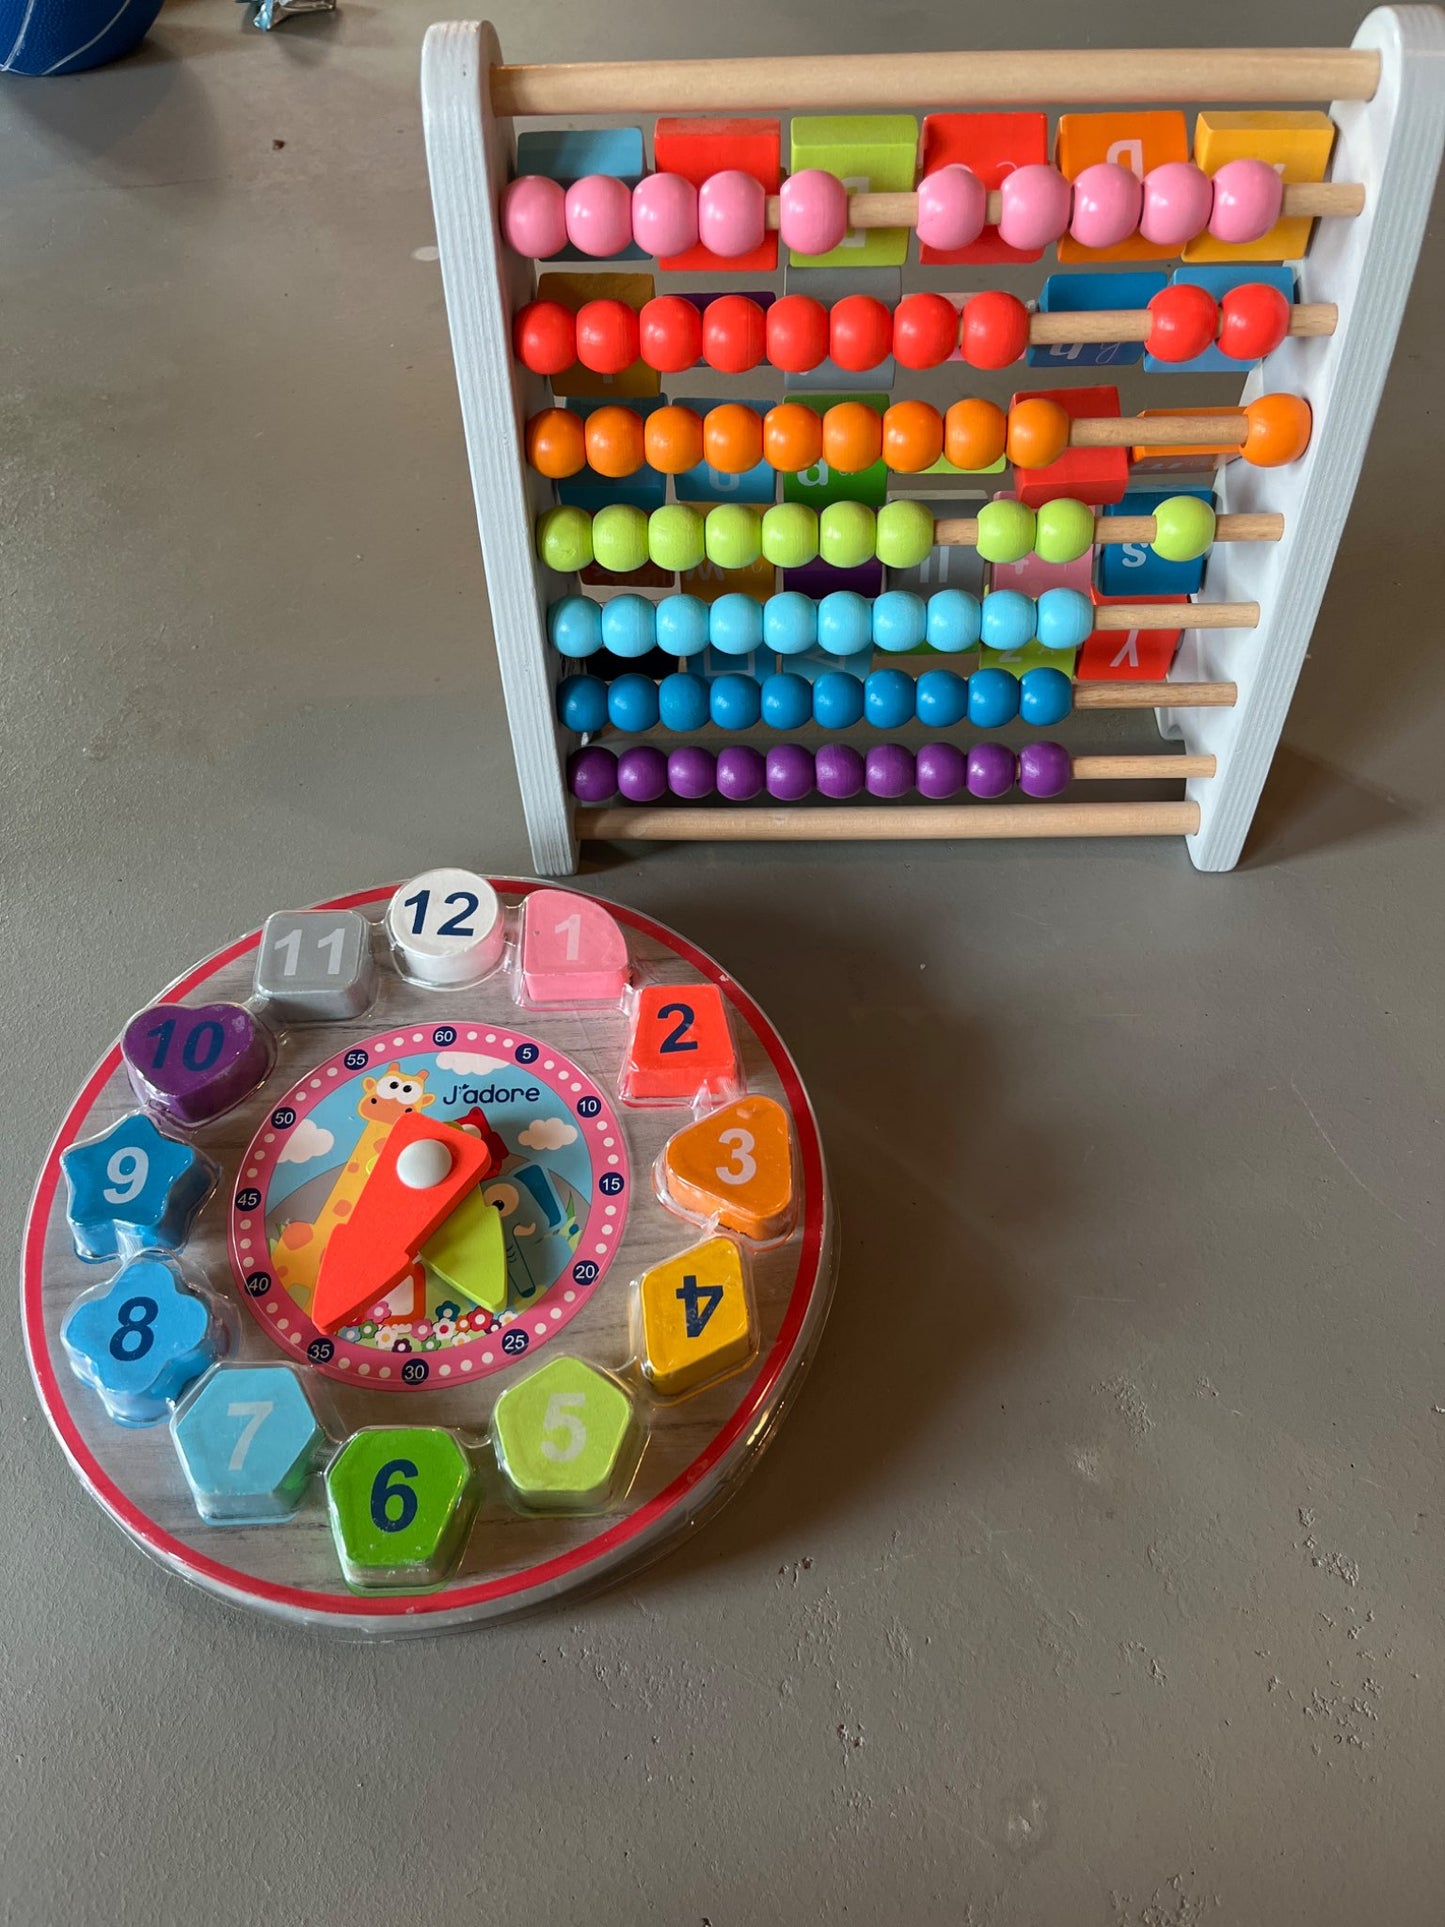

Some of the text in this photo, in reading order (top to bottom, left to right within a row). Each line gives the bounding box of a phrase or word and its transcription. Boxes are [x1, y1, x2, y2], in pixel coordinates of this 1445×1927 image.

[404, 889, 480, 937] 12
[273, 927, 347, 977] 11
[554, 913, 582, 961] 1
[434, 1030, 454, 1043] 60
[656, 1003, 699, 1054] 2
[146, 1018, 225, 1072] 10
[346, 1053, 367, 1066] 55
[522, 1047, 533, 1060] 5
[274, 1111, 294, 1125] 50
[580, 1100, 598, 1113] 10
[715, 1128, 757, 1186] 3
[102, 1146, 149, 1205] 9
[602, 1178, 621, 1191] 15
[237, 1192, 258, 1206] 45
[249, 1277, 269, 1291] 40
[575, 1265, 596, 1279] 20
[675, 1275, 724, 1338] 4
[109, 1296, 159, 1362] 8
[504, 1335, 525, 1349] 25
[309, 1344, 330, 1359] 35
[404, 1365, 425, 1379] 30
[227, 1402, 275, 1471] 7
[540, 1392, 587, 1463] 5
[370, 1458, 419, 1533] 6
